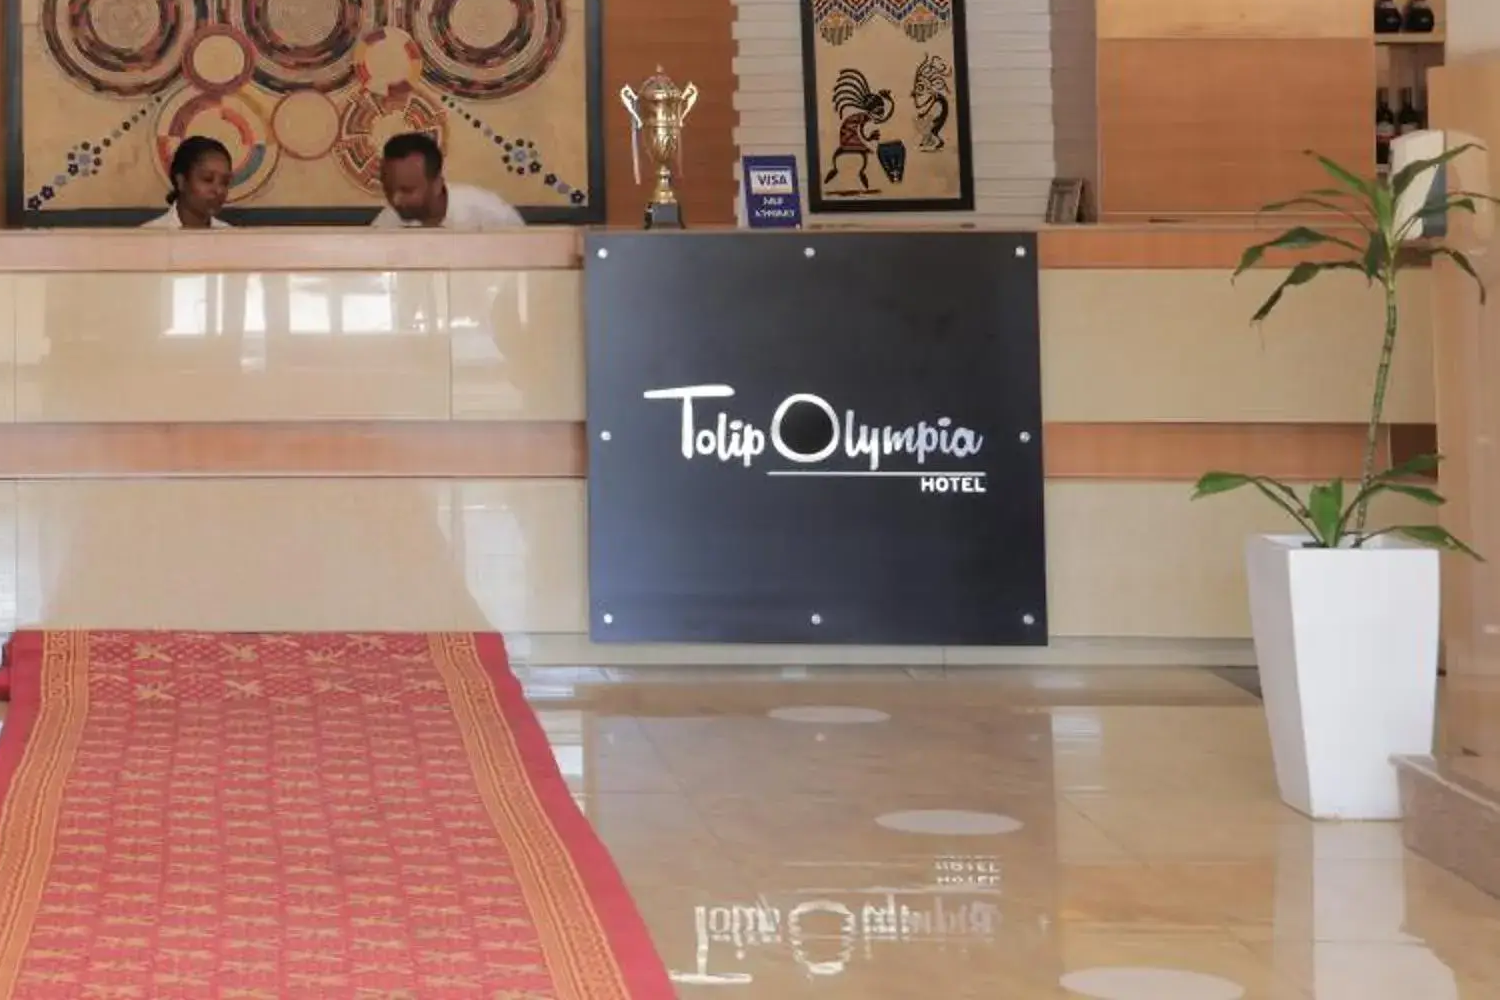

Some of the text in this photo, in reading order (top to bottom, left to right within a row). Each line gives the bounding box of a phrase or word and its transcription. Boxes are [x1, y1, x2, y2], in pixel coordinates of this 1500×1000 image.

[757, 173, 789, 186] VISA
[643, 383, 985, 471] Tolip Olympia
[920, 476, 987, 493] HOTEL
